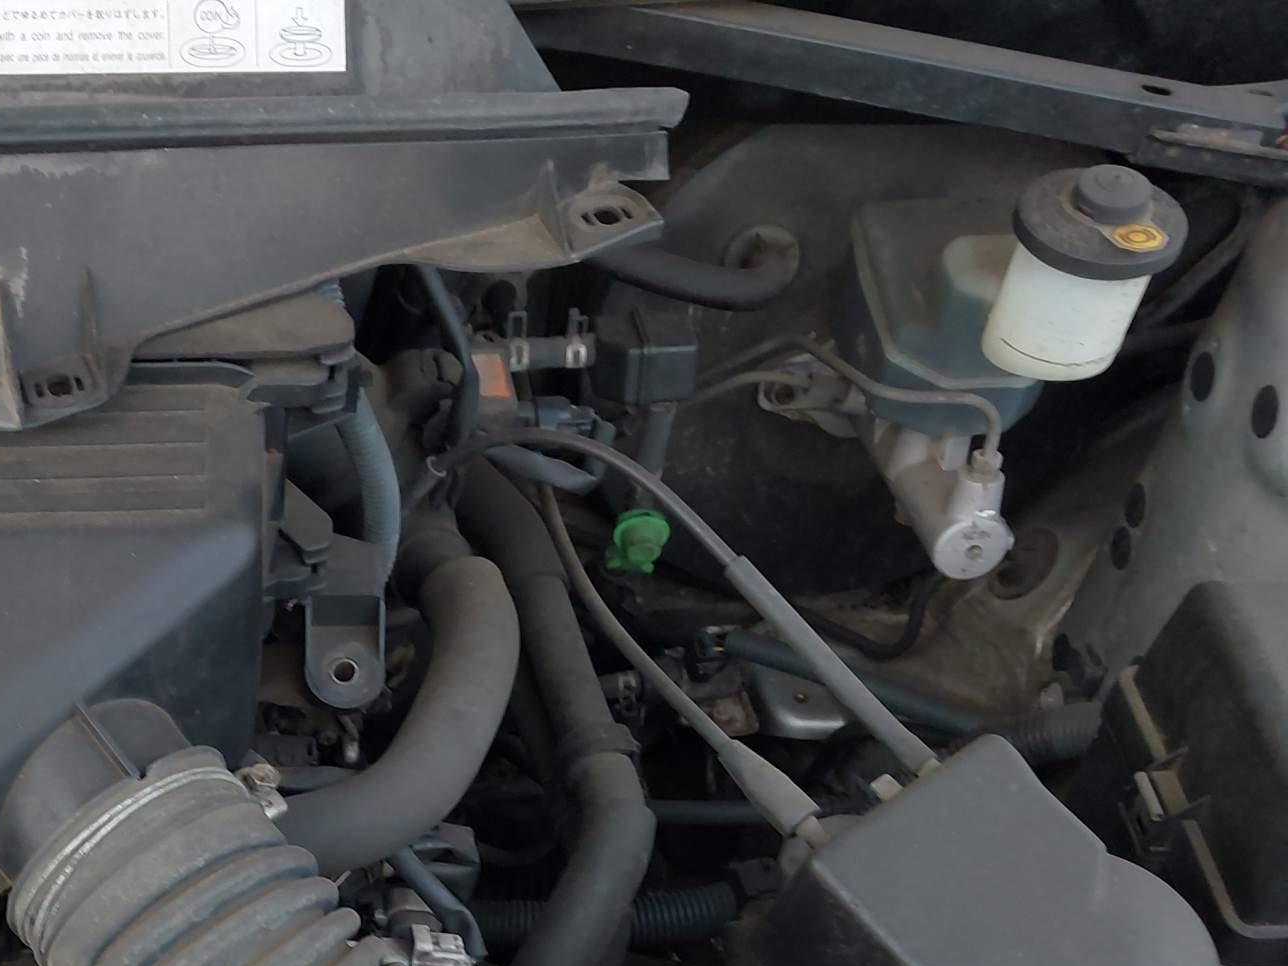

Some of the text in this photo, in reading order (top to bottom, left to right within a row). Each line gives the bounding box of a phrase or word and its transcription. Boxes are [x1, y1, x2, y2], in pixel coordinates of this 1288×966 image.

[31, 31, 51, 41] coin
[56, 31, 74, 41] and
[78, 31, 113, 41] remove
